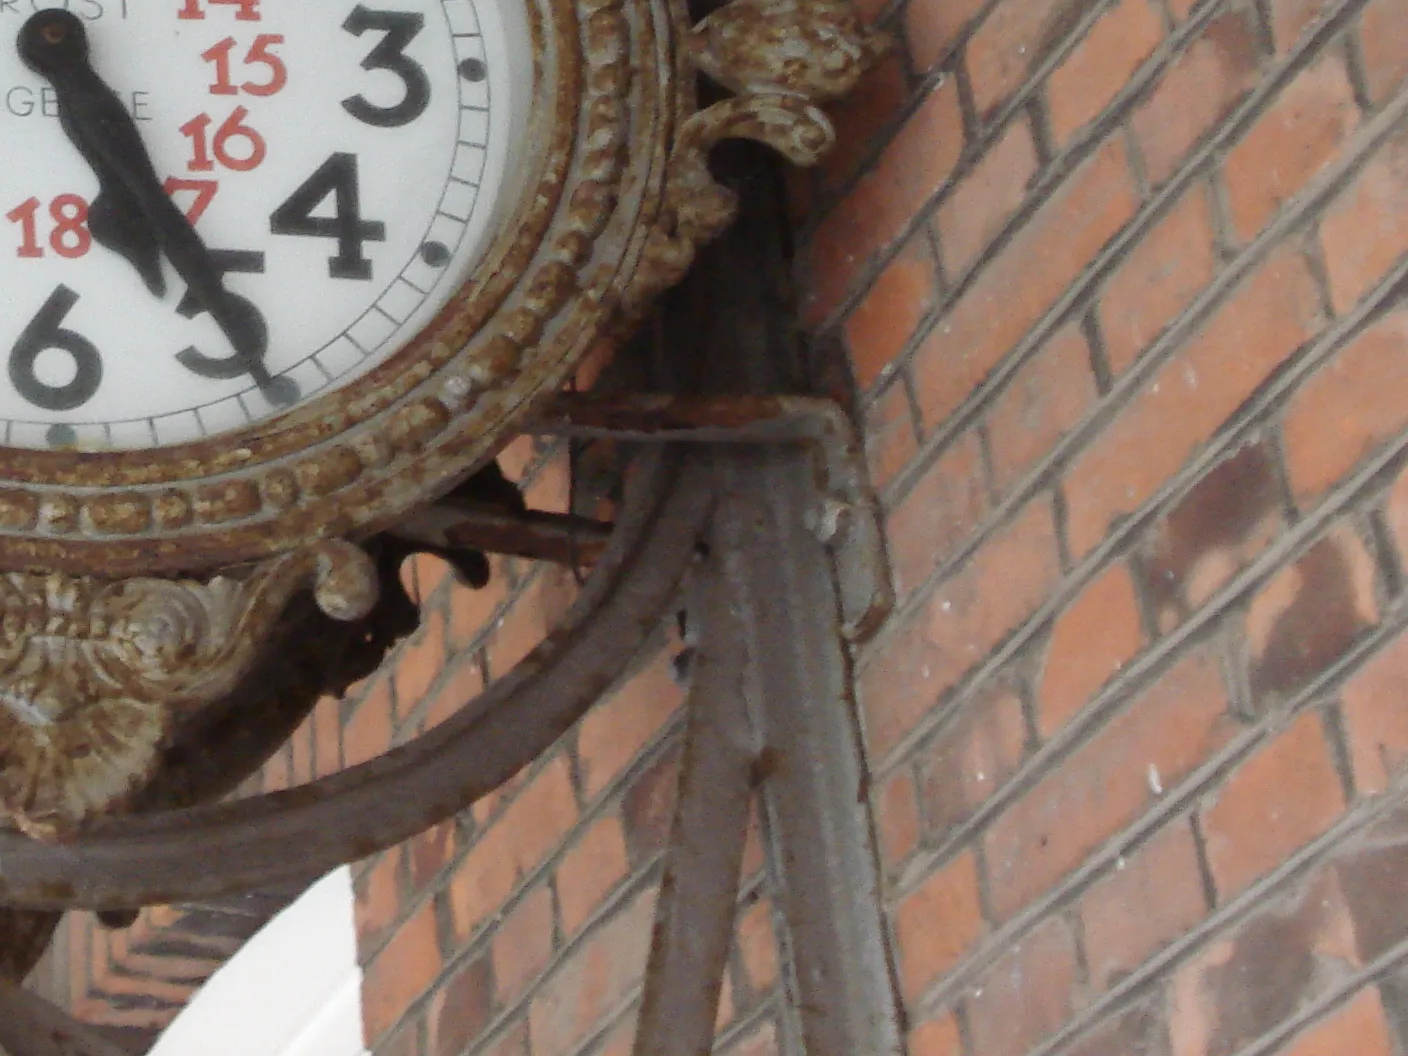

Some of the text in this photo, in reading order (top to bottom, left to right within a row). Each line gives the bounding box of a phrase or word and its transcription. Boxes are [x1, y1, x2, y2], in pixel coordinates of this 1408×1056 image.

[201, 34, 288, 97] 15
[341, 4, 432, 128] 3
[179, 107, 267, 172] 16
[5, 193, 92, 259] 18
[269, 152, 386, 280] 4
[7, 283, 103, 412] 6
[174, 247, 268, 379] 5
